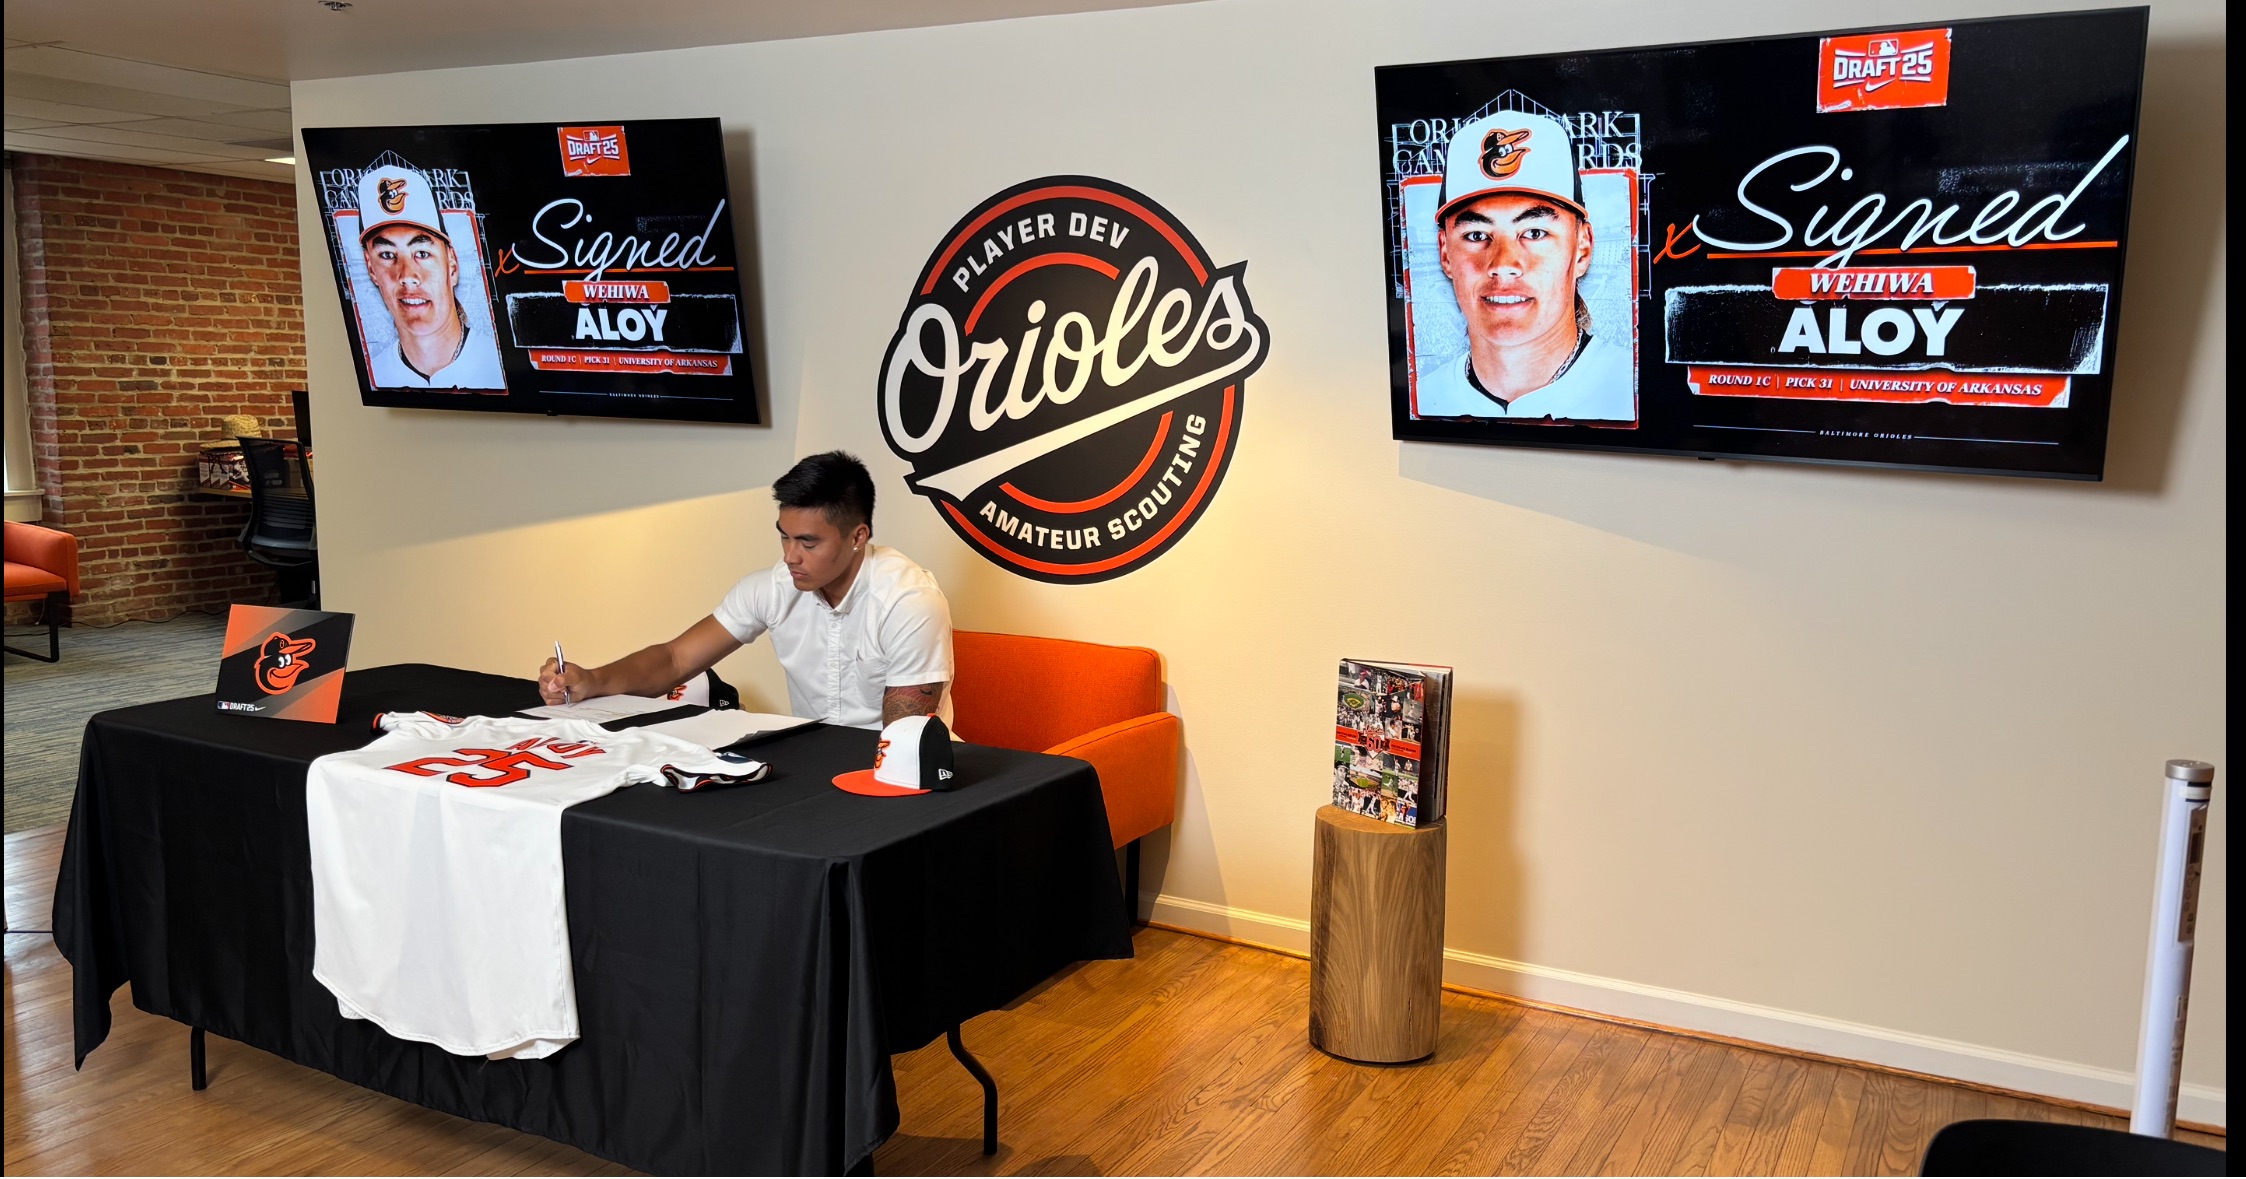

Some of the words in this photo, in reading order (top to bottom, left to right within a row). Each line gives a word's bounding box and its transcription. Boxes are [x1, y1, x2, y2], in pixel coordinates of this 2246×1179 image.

[1833, 57, 1901, 81] DRAFT
[1902, 50, 1933, 75] 25
[1558, 111, 1624, 138] ARK
[567, 139, 602, 156] DRAFT
[602, 139, 619, 155] 25
[1577, 142, 1643, 170] RDS
[421, 168, 463, 188] ARK
[434, 191, 475, 210] RDS
[1692, 134, 2130, 270] Signed
[511, 198, 726, 282] Signed
[952, 212, 1056, 294] PLAYER
[1068, 211, 1130, 250] DEV
[582, 284, 650, 300] WEHIWA
[1809, 271, 1934, 295] WEHIWA
[575, 307, 668, 342] ALOY
[1777, 306, 1966, 357] ALOY
[541, 354, 567, 364] ROUND
[568, 355, 577, 364] 1C
[584, 356, 601, 364] PICK
[602, 356, 610, 364] 31
[619, 357, 664, 367] UNIVERSITY
[664, 358, 675, 367] OF
[675, 358, 718, 369] ARKANSAS
[884, 255, 1261, 454] Orioles
[1708, 374, 1753, 387] ROUND
[1755, 375, 1771, 387] 1C
[1785, 376, 1816, 389] PICK
[1818, 378, 1834, 389] 31
[1849, 378, 1936, 393] UNIVERSITY
[1937, 381, 1957, 393] OF
[1958, 381, 2043, 396] ARKANSAS
[1819, 429, 1870, 438] BALTIMORE
[979, 499, 1102, 550] AMATEUR
[1107, 413, 1207, 541] SCOUTING
[383, 748, 575, 788] 25
